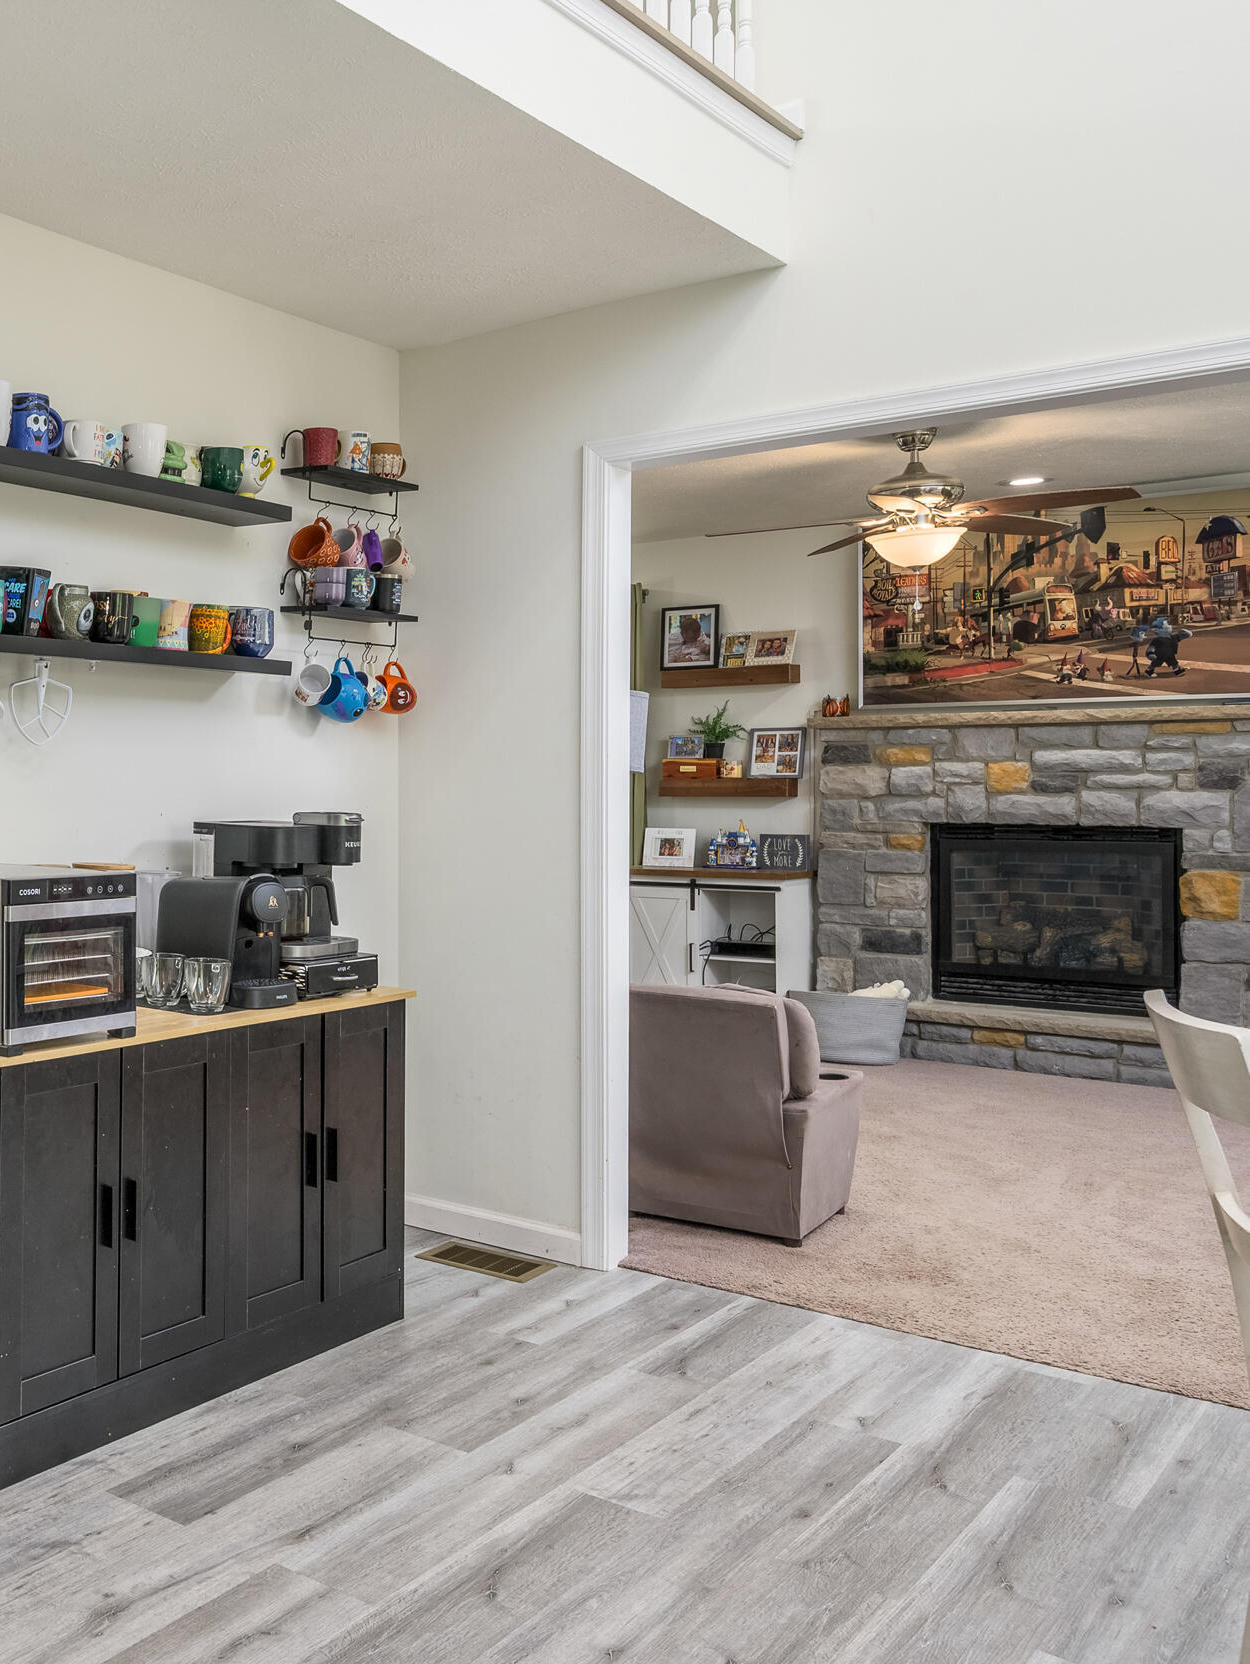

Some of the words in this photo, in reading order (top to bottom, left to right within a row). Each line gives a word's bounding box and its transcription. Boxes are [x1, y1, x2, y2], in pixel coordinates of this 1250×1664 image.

[773, 838, 791, 851] LOVE
[773, 855, 792, 867] MORE
[19, 888, 41, 896] COSORI
